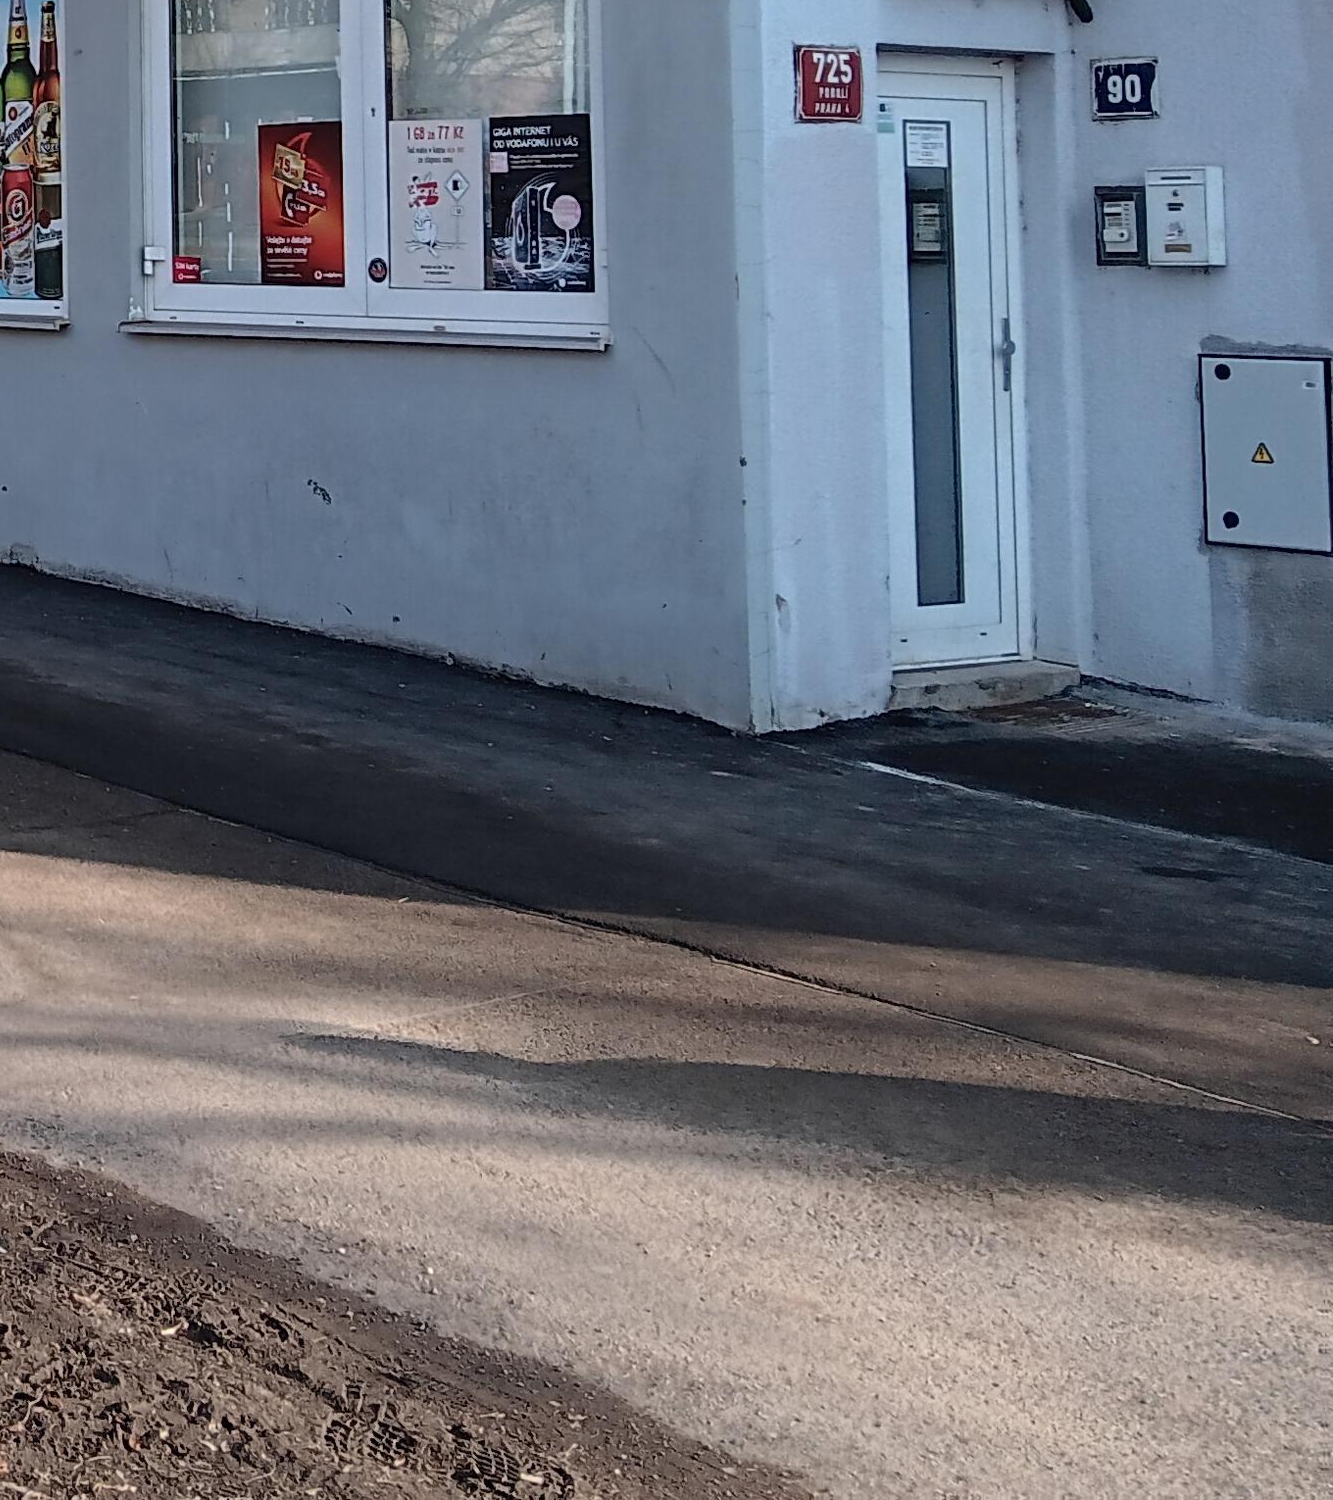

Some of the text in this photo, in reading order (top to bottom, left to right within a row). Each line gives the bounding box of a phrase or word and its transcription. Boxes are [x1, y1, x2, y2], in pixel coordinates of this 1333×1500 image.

[812, 52, 853, 84] 725
[1107, 74, 1142, 104] 90
[815, 103, 842, 114] PRAHA
[437, 125, 450, 140] 77
[493, 125, 551, 137] GIGA INTERNET
